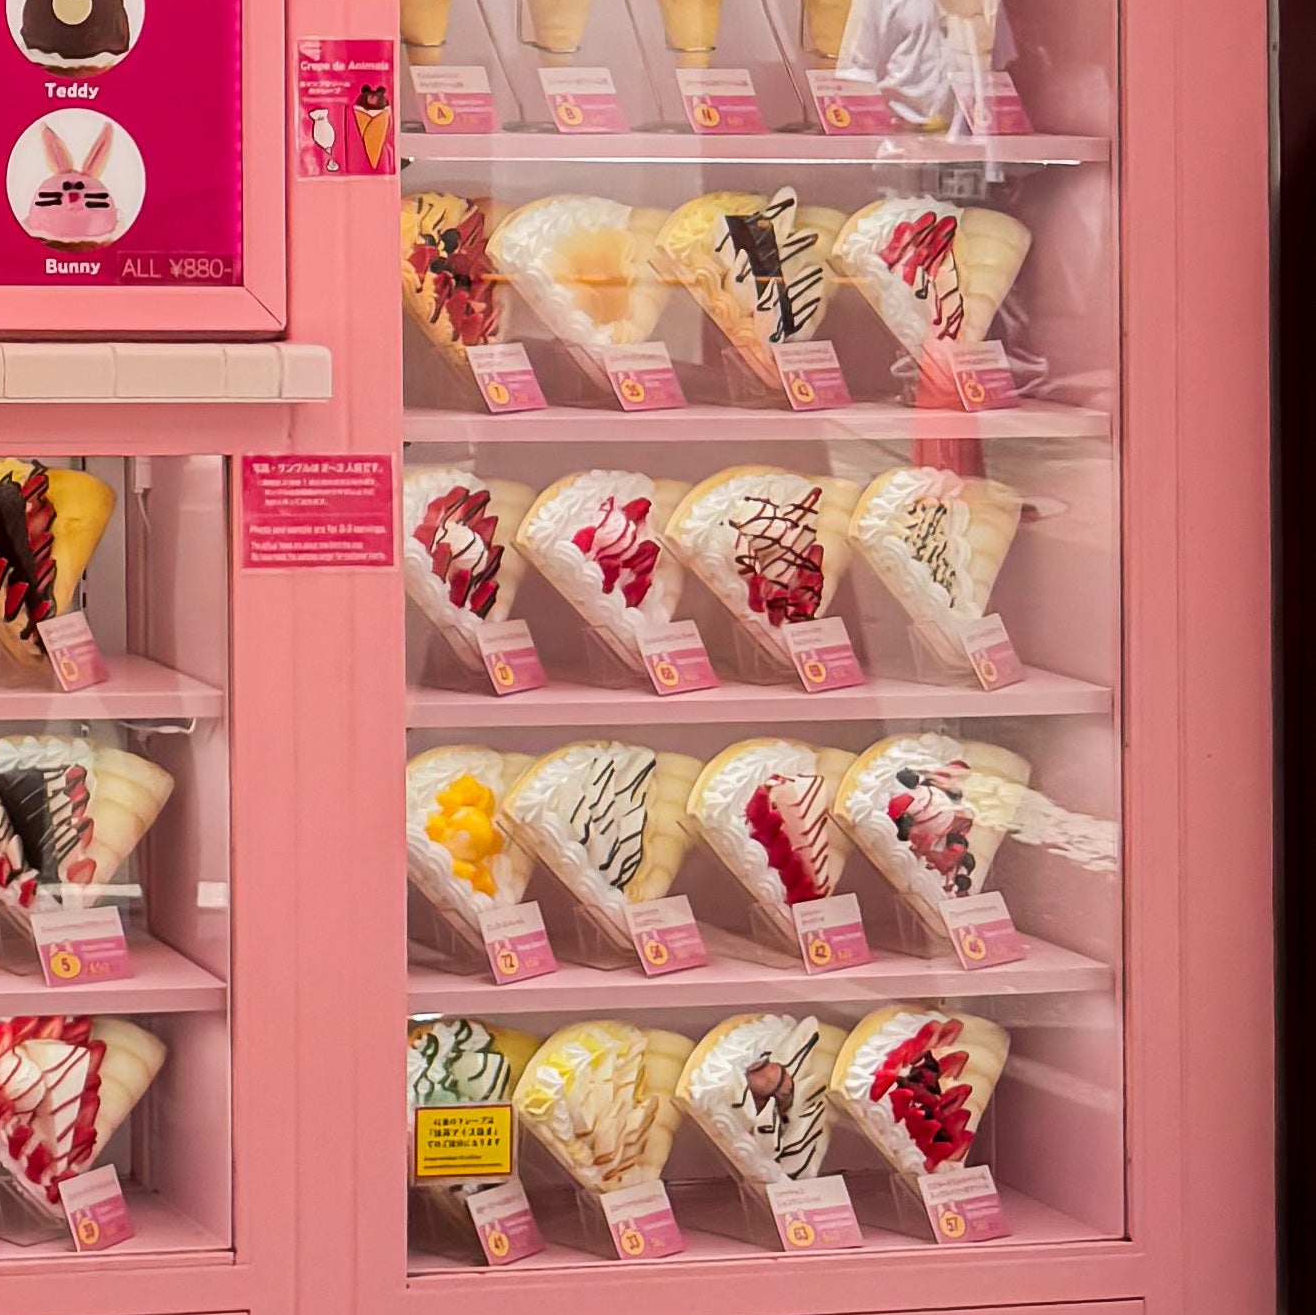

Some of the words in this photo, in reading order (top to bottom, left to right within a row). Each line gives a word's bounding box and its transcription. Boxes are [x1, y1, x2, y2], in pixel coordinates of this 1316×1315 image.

[44, 82, 100, 99] Teddy
[45, 258, 101, 276] Bunny
[122, 259, 162, 277] ALL
